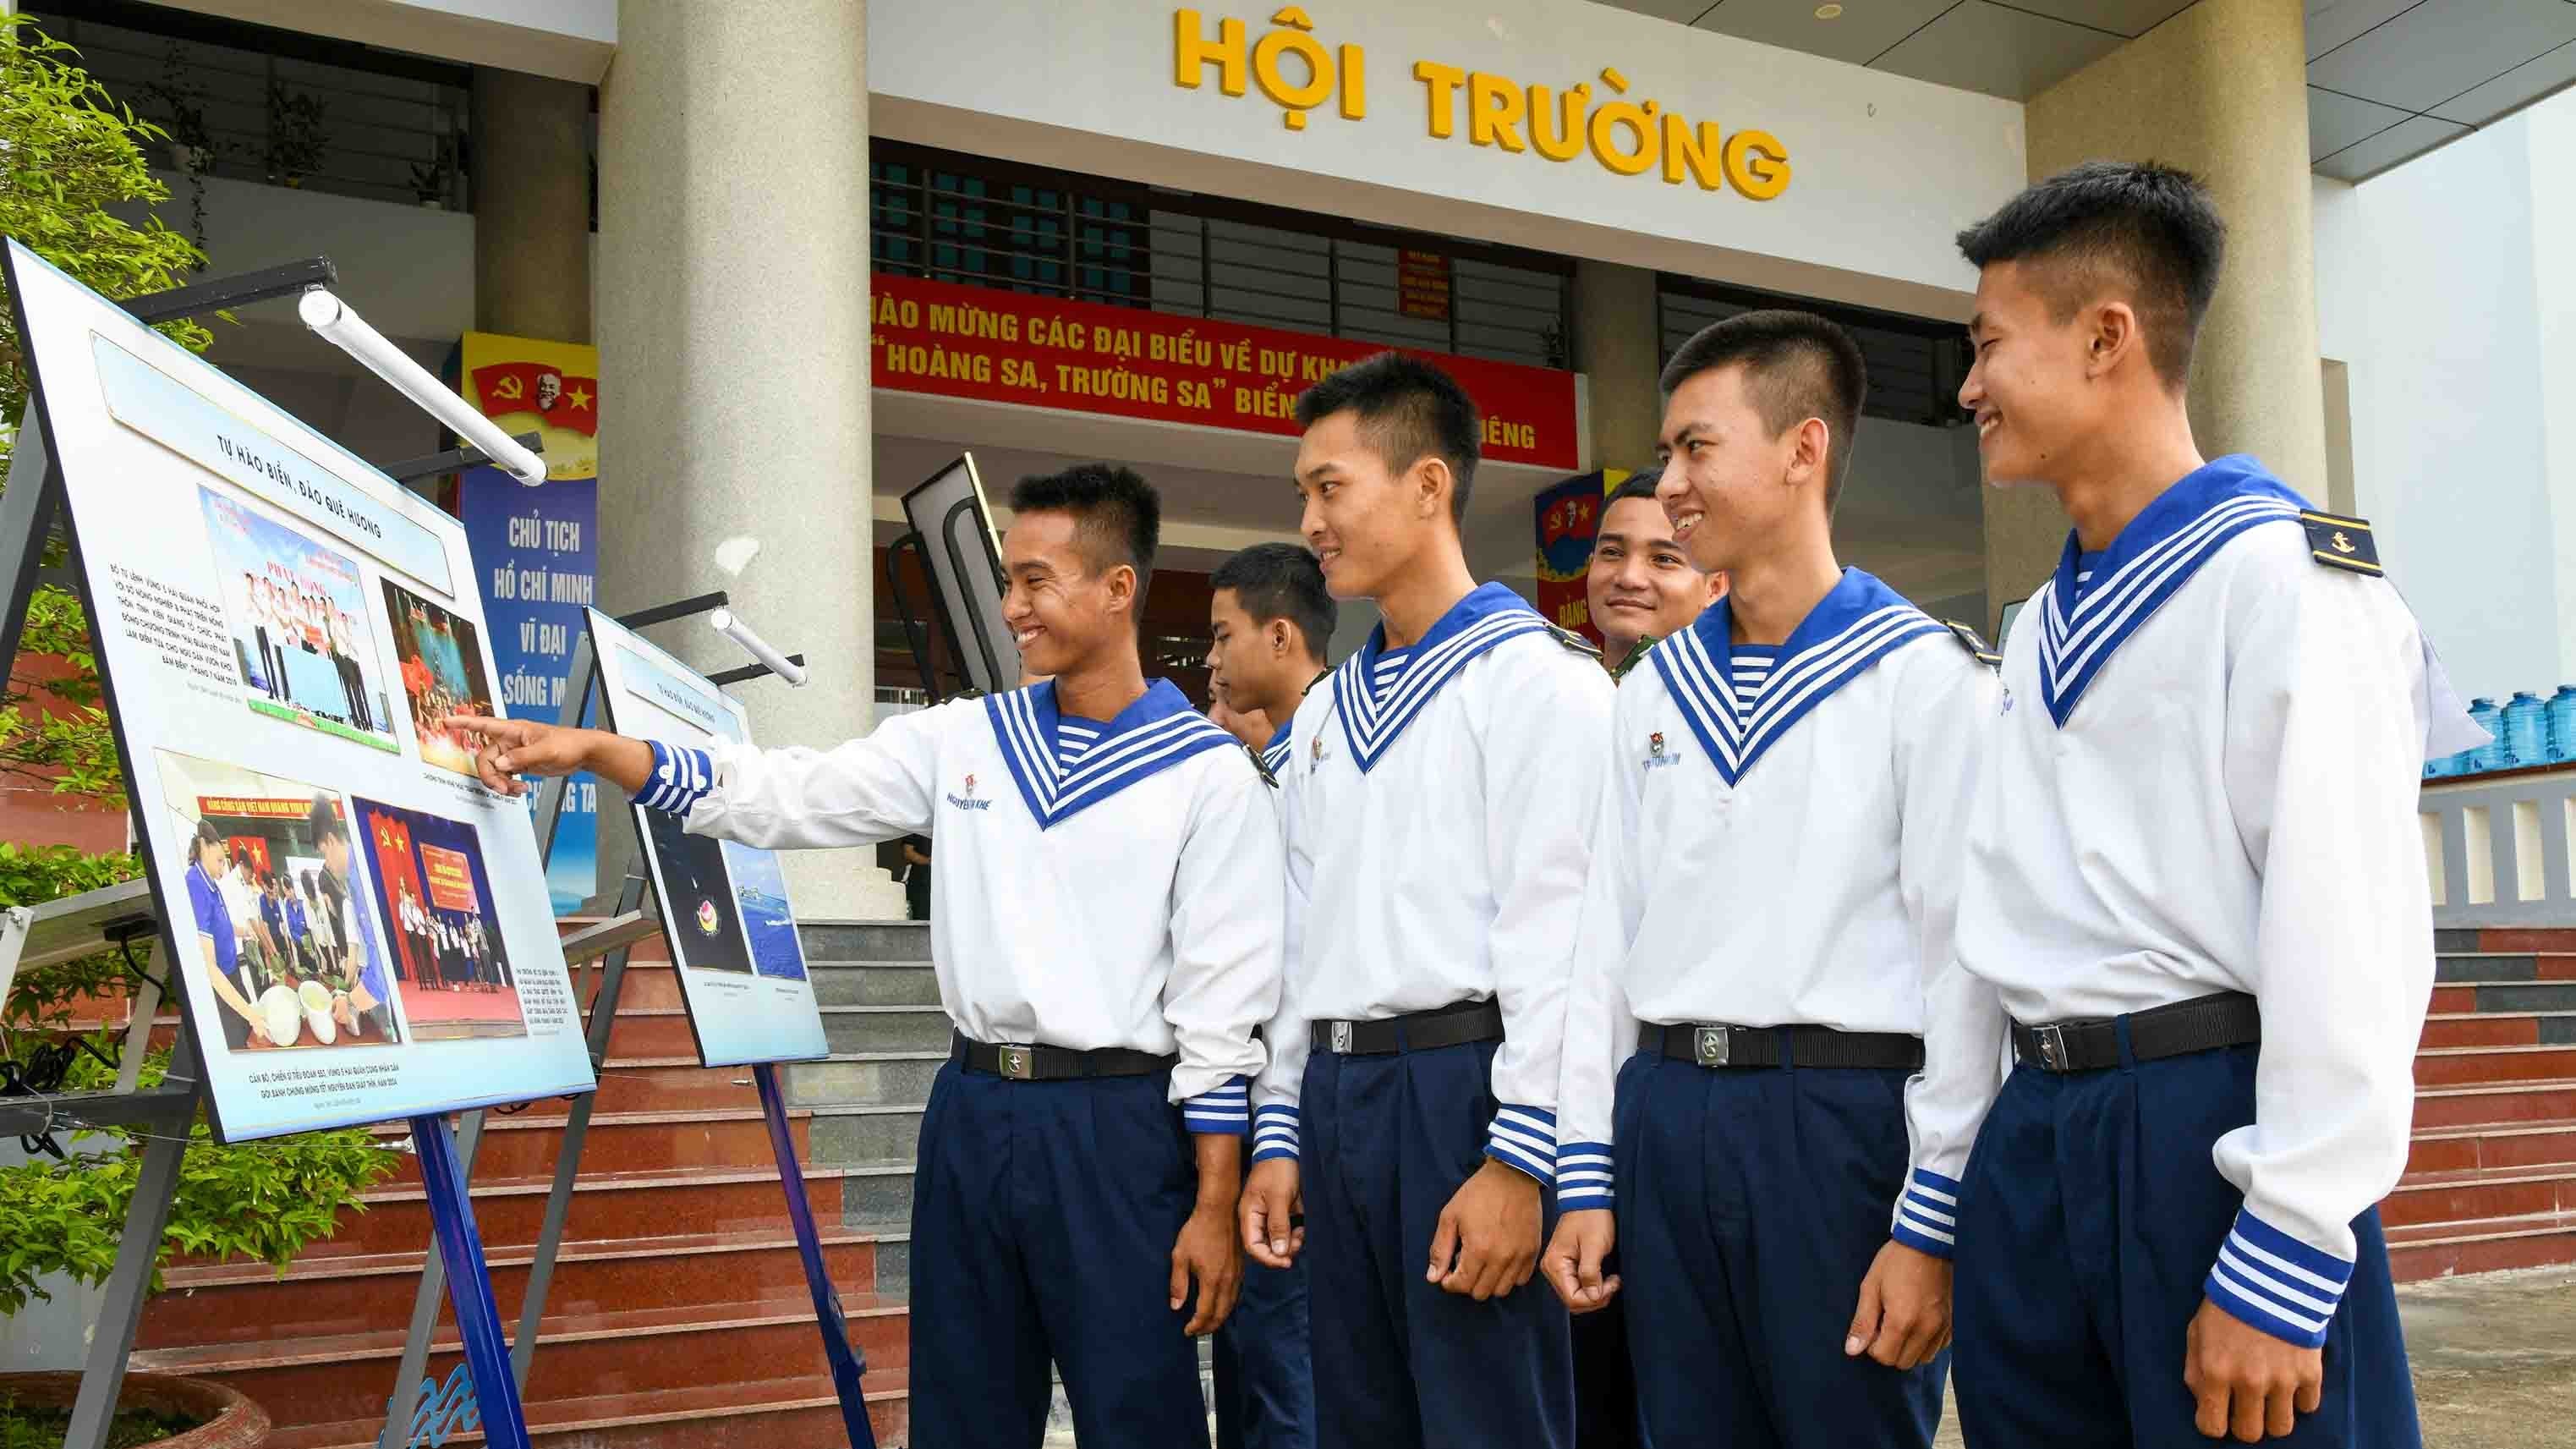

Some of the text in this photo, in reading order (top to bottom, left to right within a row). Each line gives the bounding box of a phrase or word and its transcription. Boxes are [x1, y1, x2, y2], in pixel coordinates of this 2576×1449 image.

[1173, 5, 1792, 201] HỘI TRƯỜNG
[929, 302, 1018, 343] MỪNG
[1028, 315, 1085, 351] CÁC
[1093, 326, 1141, 362] ĐẠI
[1150, 328, 1212, 366] BIỂU
[1219, 338, 1252, 373] VỀ
[1259, 348, 1297, 383] DỰ
[1000, 358, 1048, 393] SA,
[1056, 365, 1168, 404] TRƯỜNG
[1236, 381, 1298, 420] BIỂN
[236, 446, 263, 474] HÀO
[325, 496, 345, 519] QUÊ
[509, 508, 580, 557] CHỦ TỊCH
[521, 566, 547, 601] CHÍ
[552, 573, 594, 605] MINH
[519, 617, 567, 662] VĨ ĐẠI
[503, 664, 548, 707] SỐNG
[581, 782, 597, 813] TA
